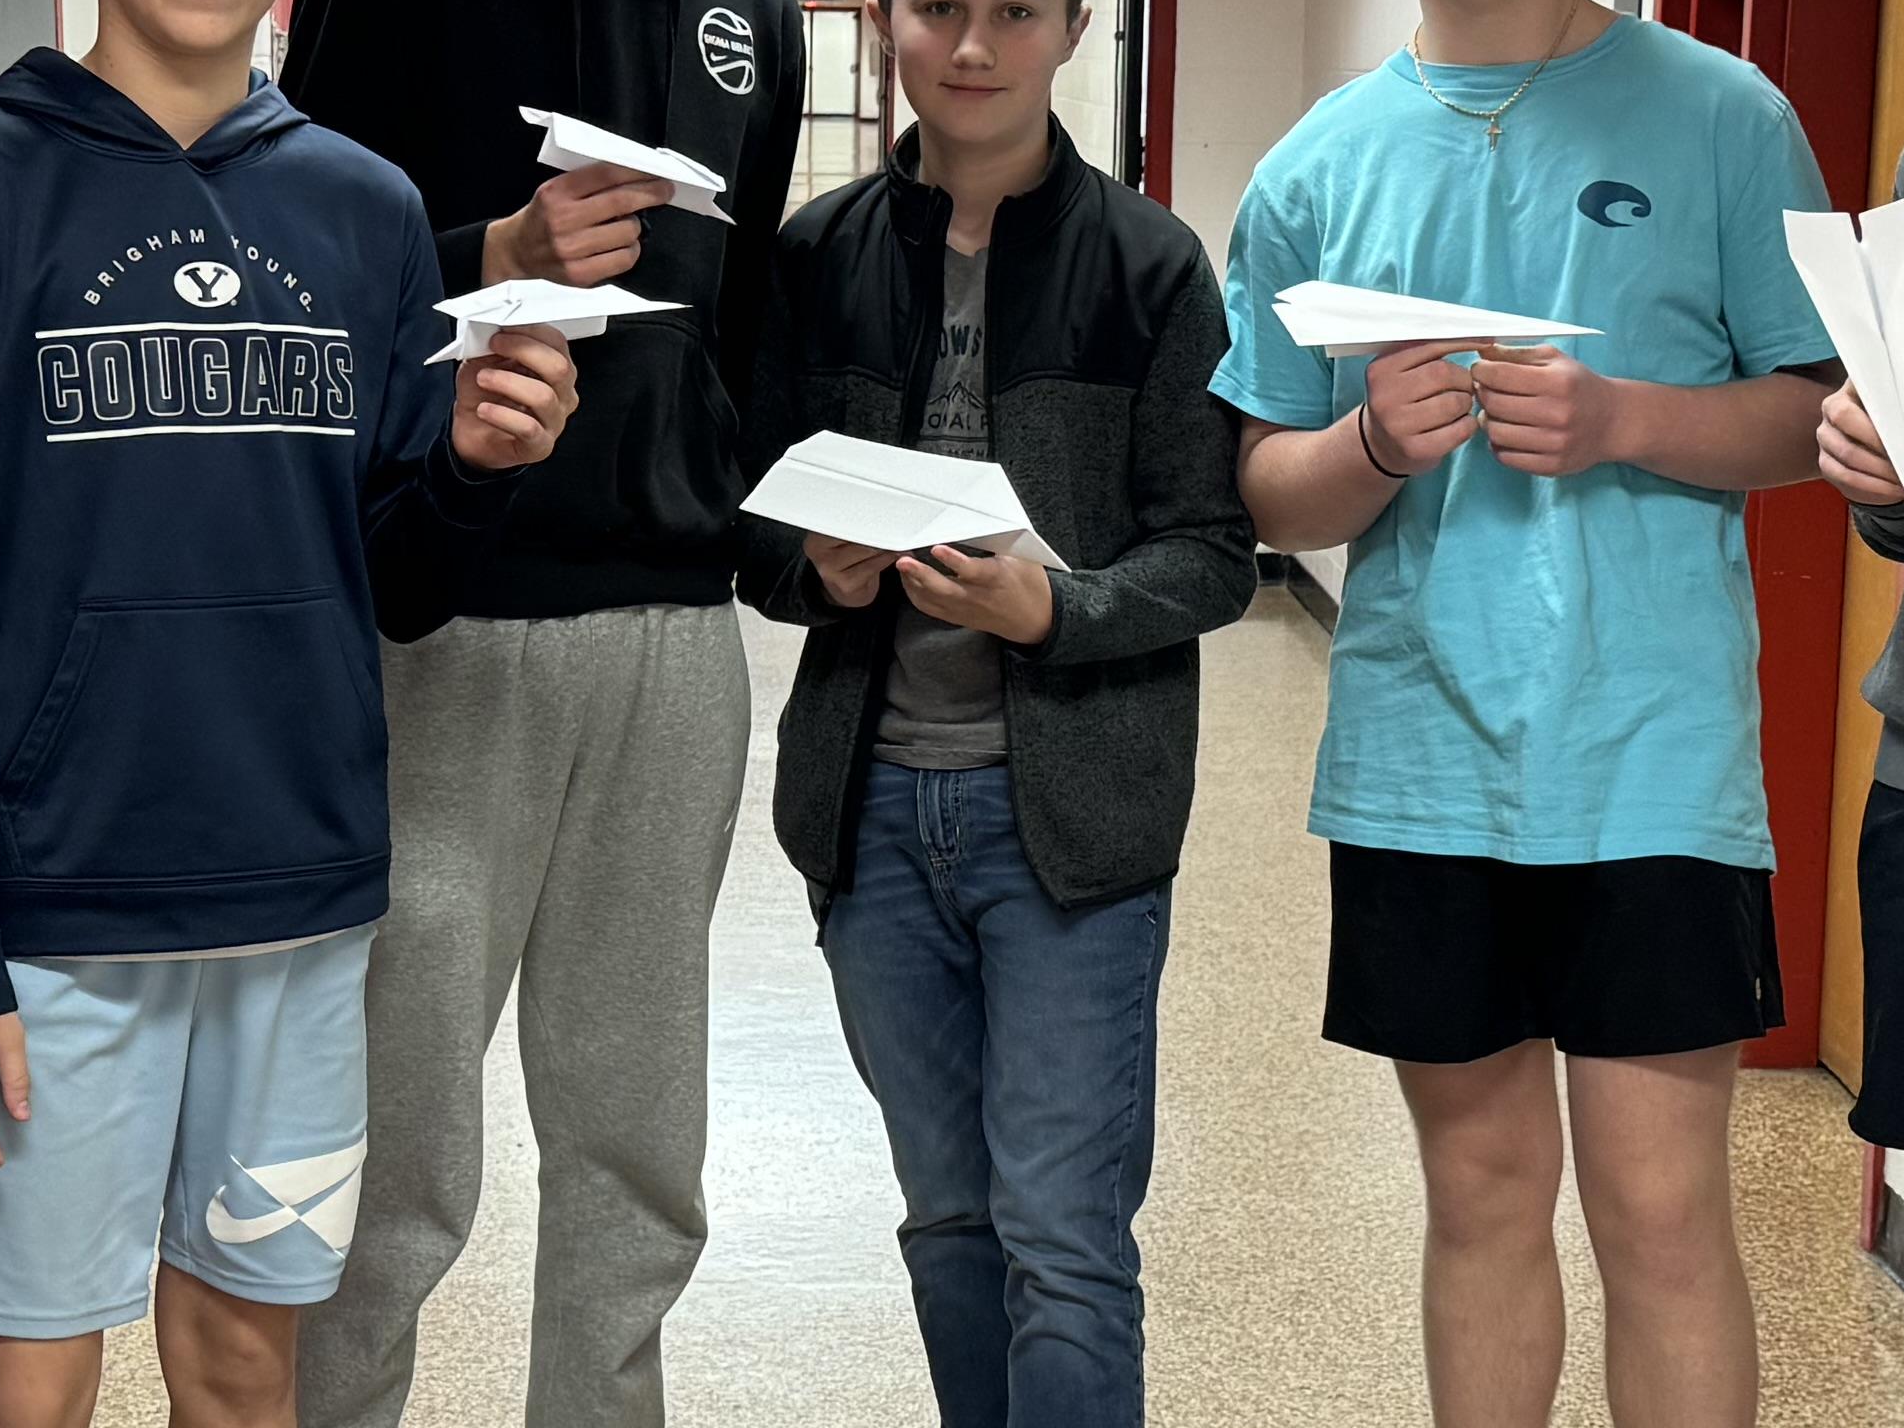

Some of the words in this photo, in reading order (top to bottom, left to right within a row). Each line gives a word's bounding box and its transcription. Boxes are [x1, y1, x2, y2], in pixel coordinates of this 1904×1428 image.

[83, 228, 205, 306] BRIGHAM
[183, 266, 229, 303] Y
[37, 336, 354, 425] COUGARS
